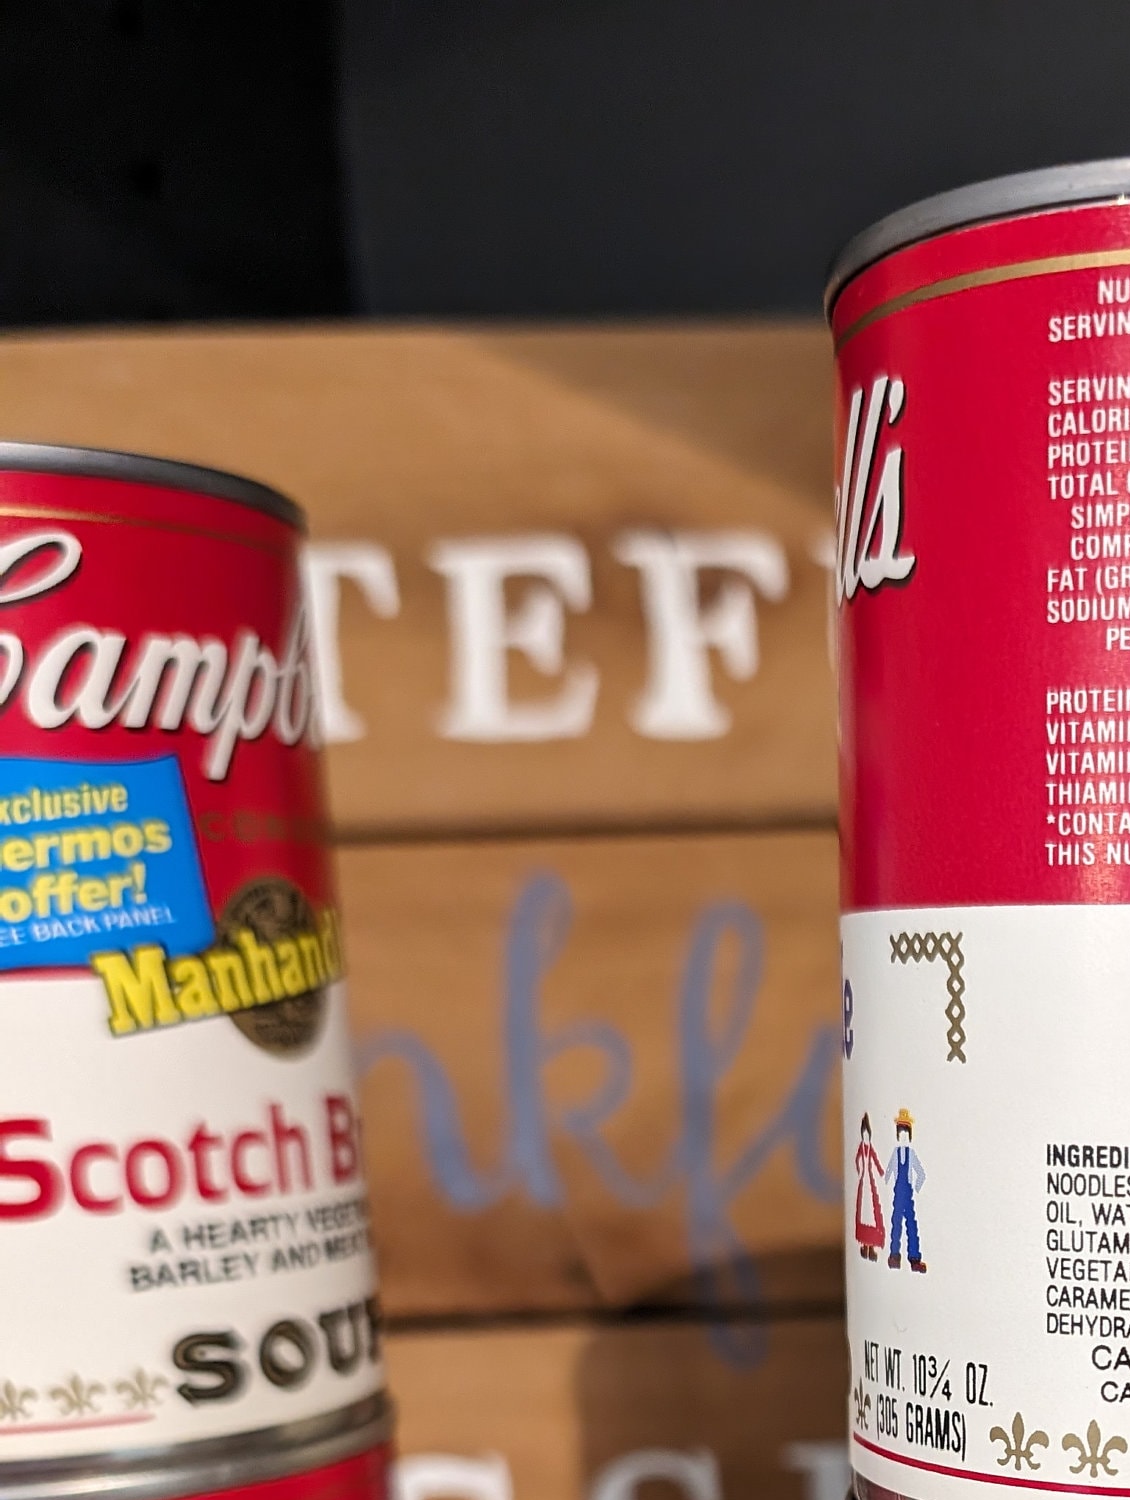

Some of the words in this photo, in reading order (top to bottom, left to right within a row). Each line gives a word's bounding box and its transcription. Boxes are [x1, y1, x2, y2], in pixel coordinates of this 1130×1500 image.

[1048, 470, 1118, 500] TOTAL
[0, 783, 128, 826] xclusive
[0, 820, 173, 872] ermos
[1046, 843, 1097, 866] THIS
[0, 862, 147, 923] offer!
[0, 1098, 312, 1224] Scotch
[149, 1226, 173, 1252] A
[183, 1215, 298, 1250] HEARTY
[129, 1252, 261, 1293] BARLEY
[271, 1241, 321, 1272] AND
[864, 1339, 880, 1383] NET
[884, 1346, 904, 1392] WT.
[966, 1362, 994, 1408] OZ.
[876, 1390, 899, 1439] (305
[905, 1401, 966, 1462] GRAMS)
